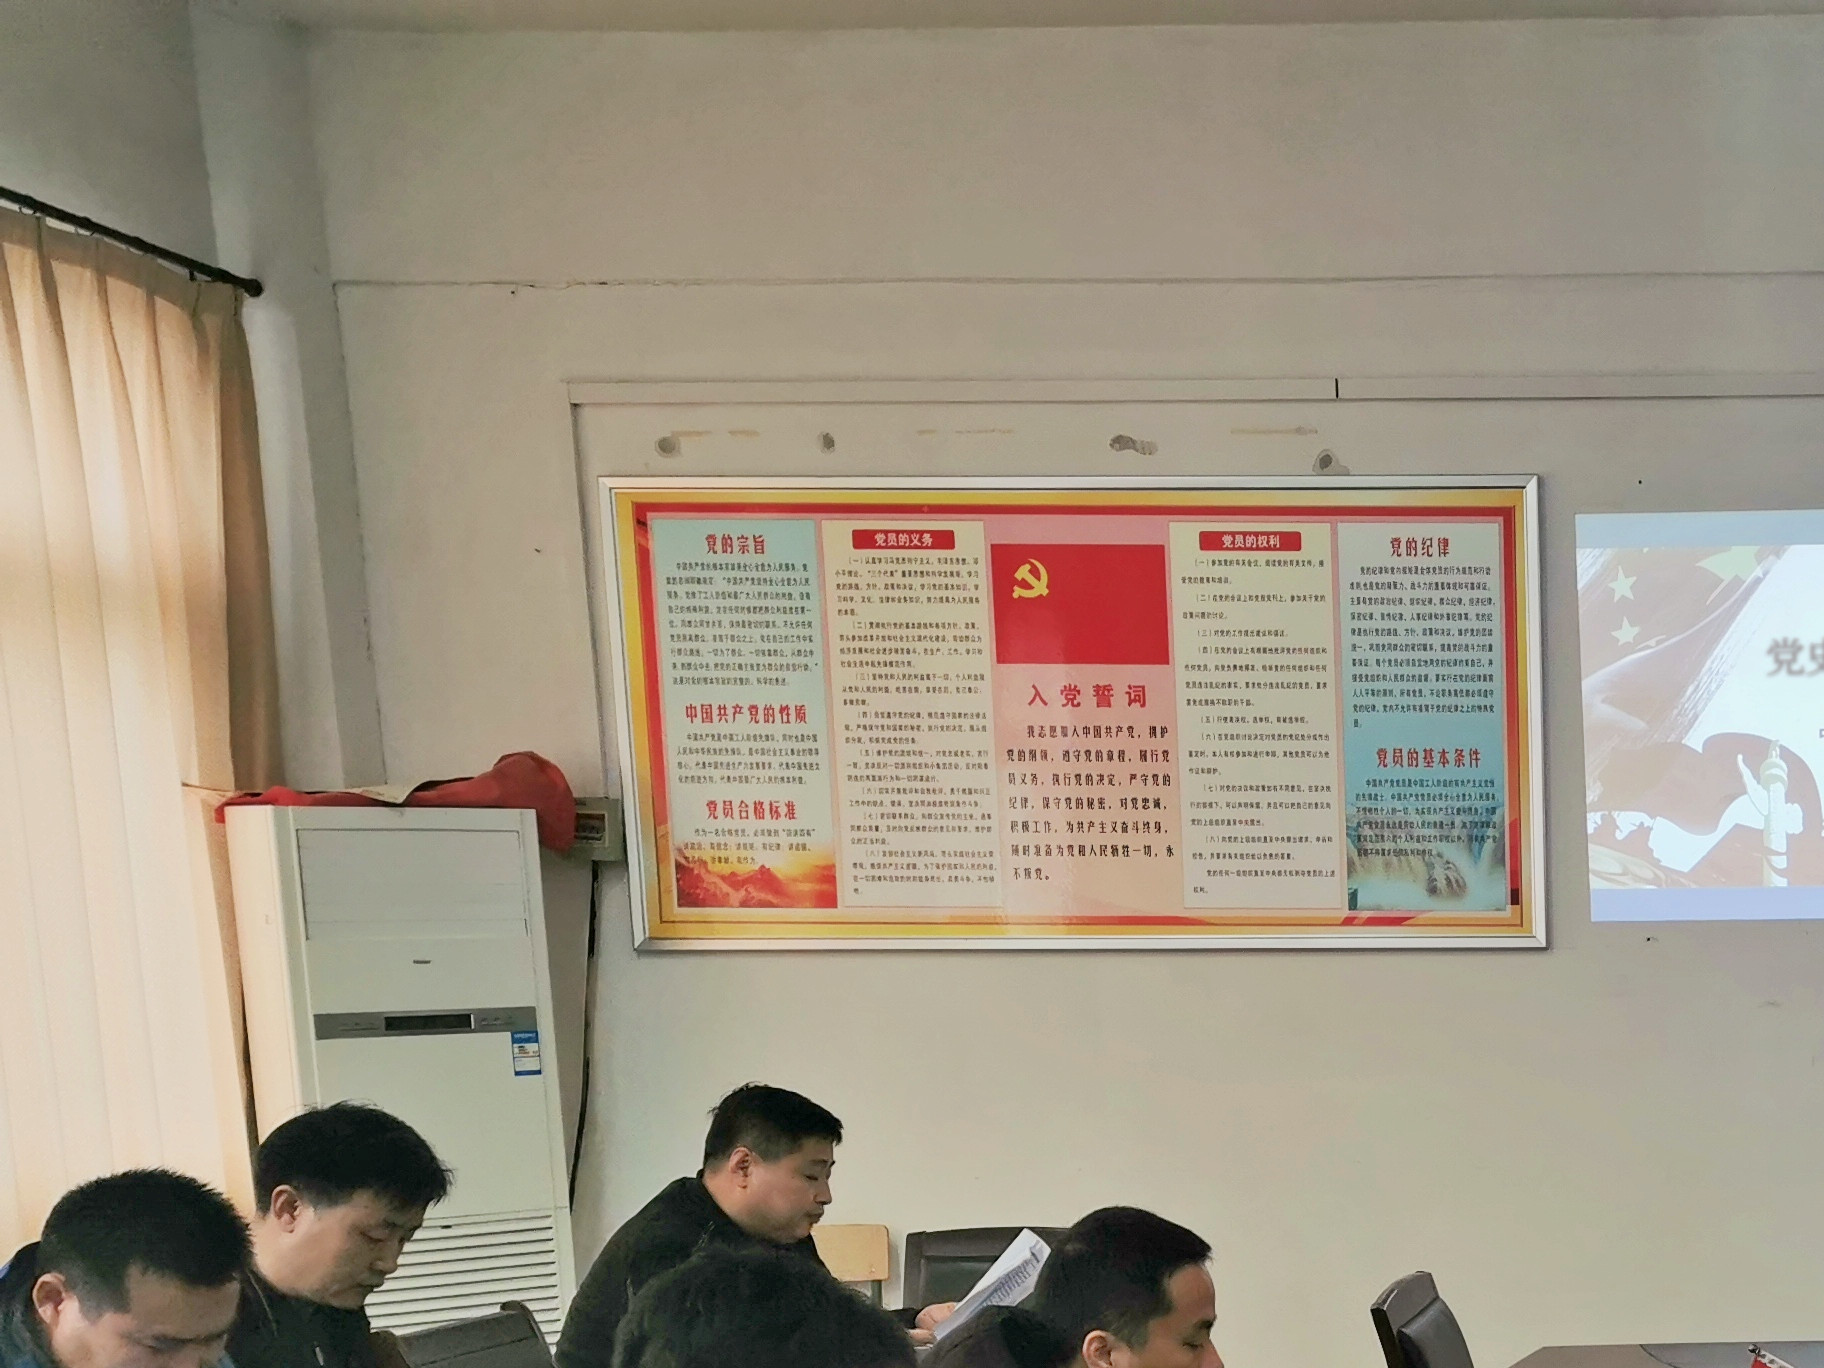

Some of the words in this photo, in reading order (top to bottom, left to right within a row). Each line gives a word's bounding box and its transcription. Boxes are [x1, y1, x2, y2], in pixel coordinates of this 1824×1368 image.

[705, 534, 765, 554] 党的宗旨
[875, 533, 932, 546] 党员的义务
[1222, 534, 1280, 548] 党员的权利
[1390, 537, 1450, 557] 党的纪律
[1028, 683, 1147, 708] 入党誓词
[686, 704, 808, 724] 中国共产党的性质
[1376, 748, 1481, 768] 党员的基本条件
[706, 800, 797, 820] 党员合格标准
